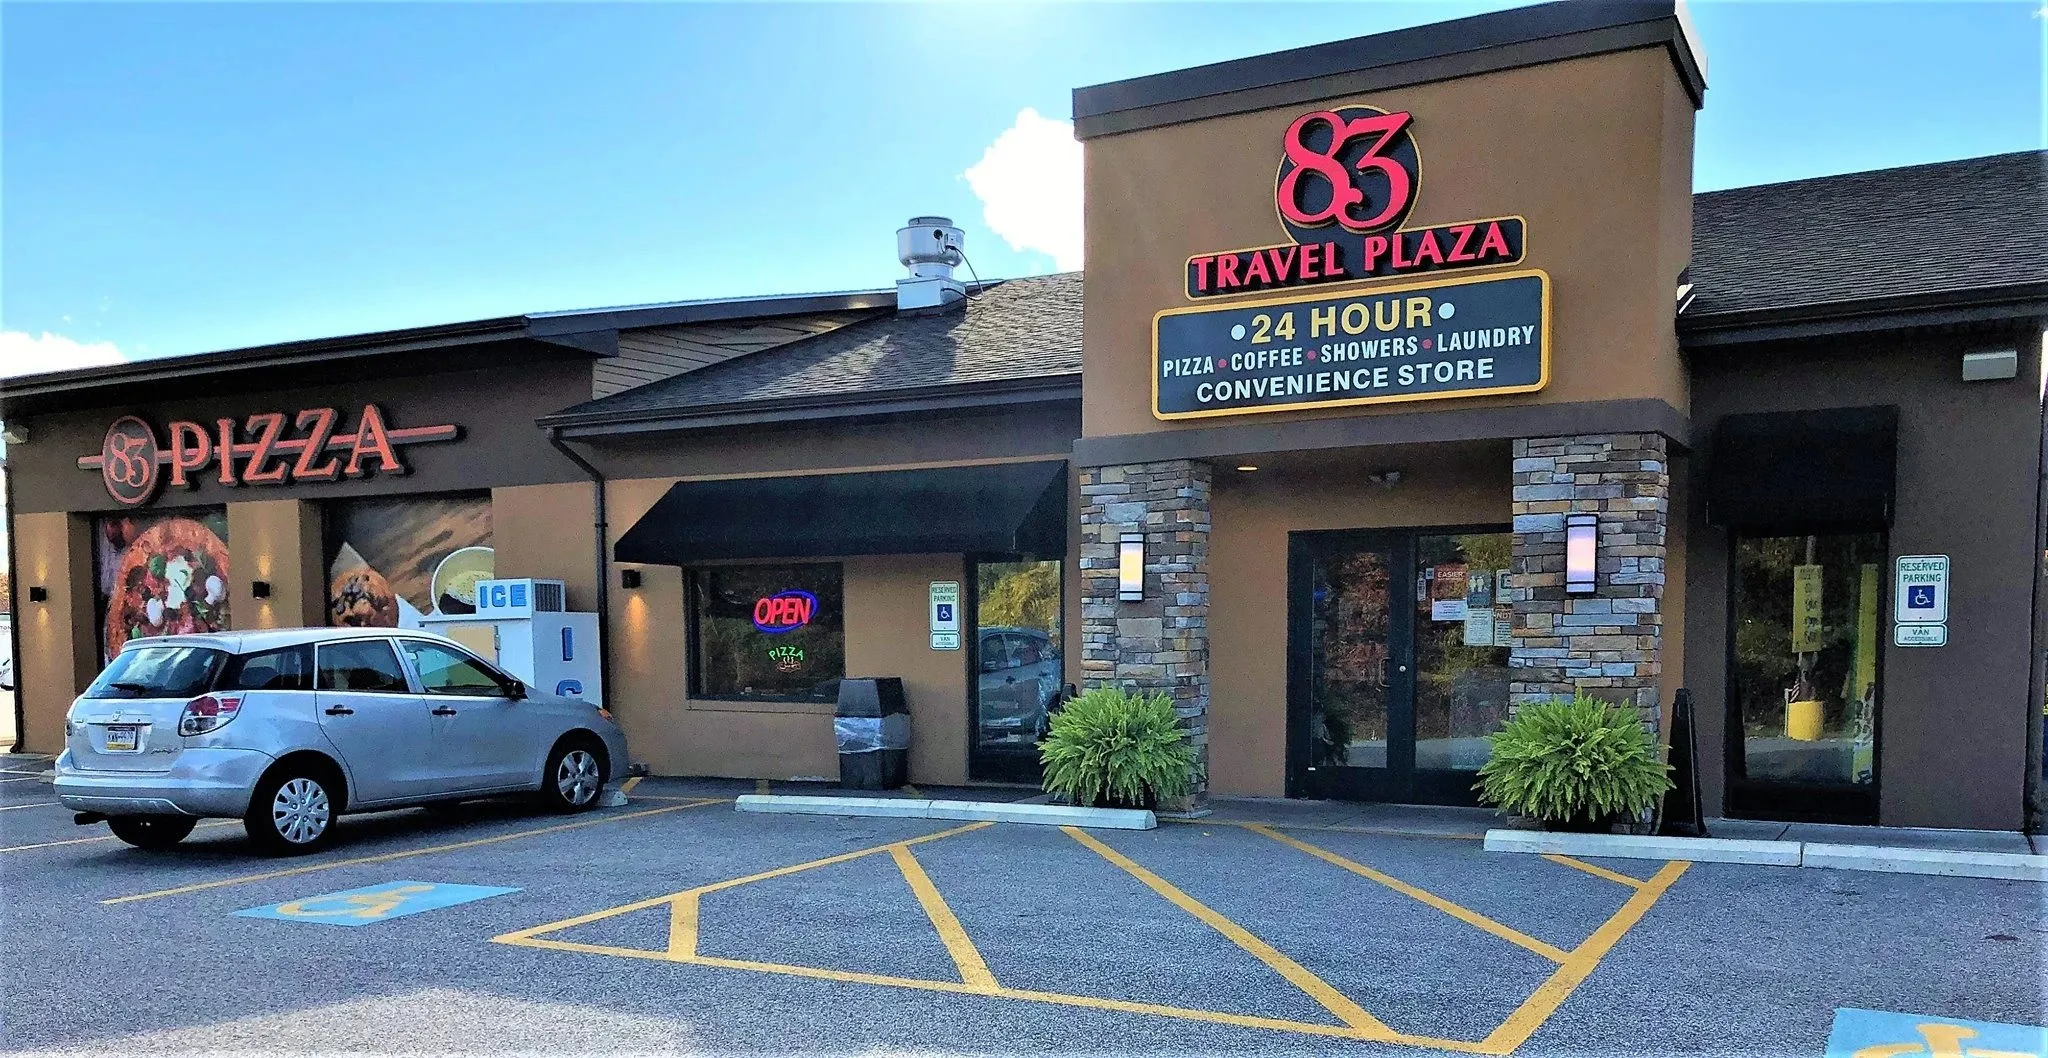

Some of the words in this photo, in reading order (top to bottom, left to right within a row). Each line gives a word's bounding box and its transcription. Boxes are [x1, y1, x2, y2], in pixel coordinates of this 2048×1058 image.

[1277, 110, 1413, 229] 83
[1191, 241, 1344, 291] TRAVEL
[1363, 221, 1510, 271] PLAZA
[1251, 312, 1296, 345] 24
[1311, 296, 1432, 339] HOUR
[1163, 356, 1215, 378] PIZZA
[1231, 347, 1303, 372] COFFEE
[1320, 336, 1418, 364] SHOWERS
[1437, 325, 1535, 353] LAUNDRY
[1196, 367, 1389, 403] CONVENIENCE
[1398, 357, 1494, 386] STORE
[108, 432, 150, 488] 83
[168, 403, 400, 487] PIZZA
[1900, 562, 1945, 571] RESERVED
[1903, 573, 1942, 582] PARKING
[479, 584, 527, 609] ICE
[753, 597, 811, 625] OPEN
[931, 586, 956, 594] RESERVED
[556, 627, 583, 697] IC
[768, 646, 804, 661] PIZZA
